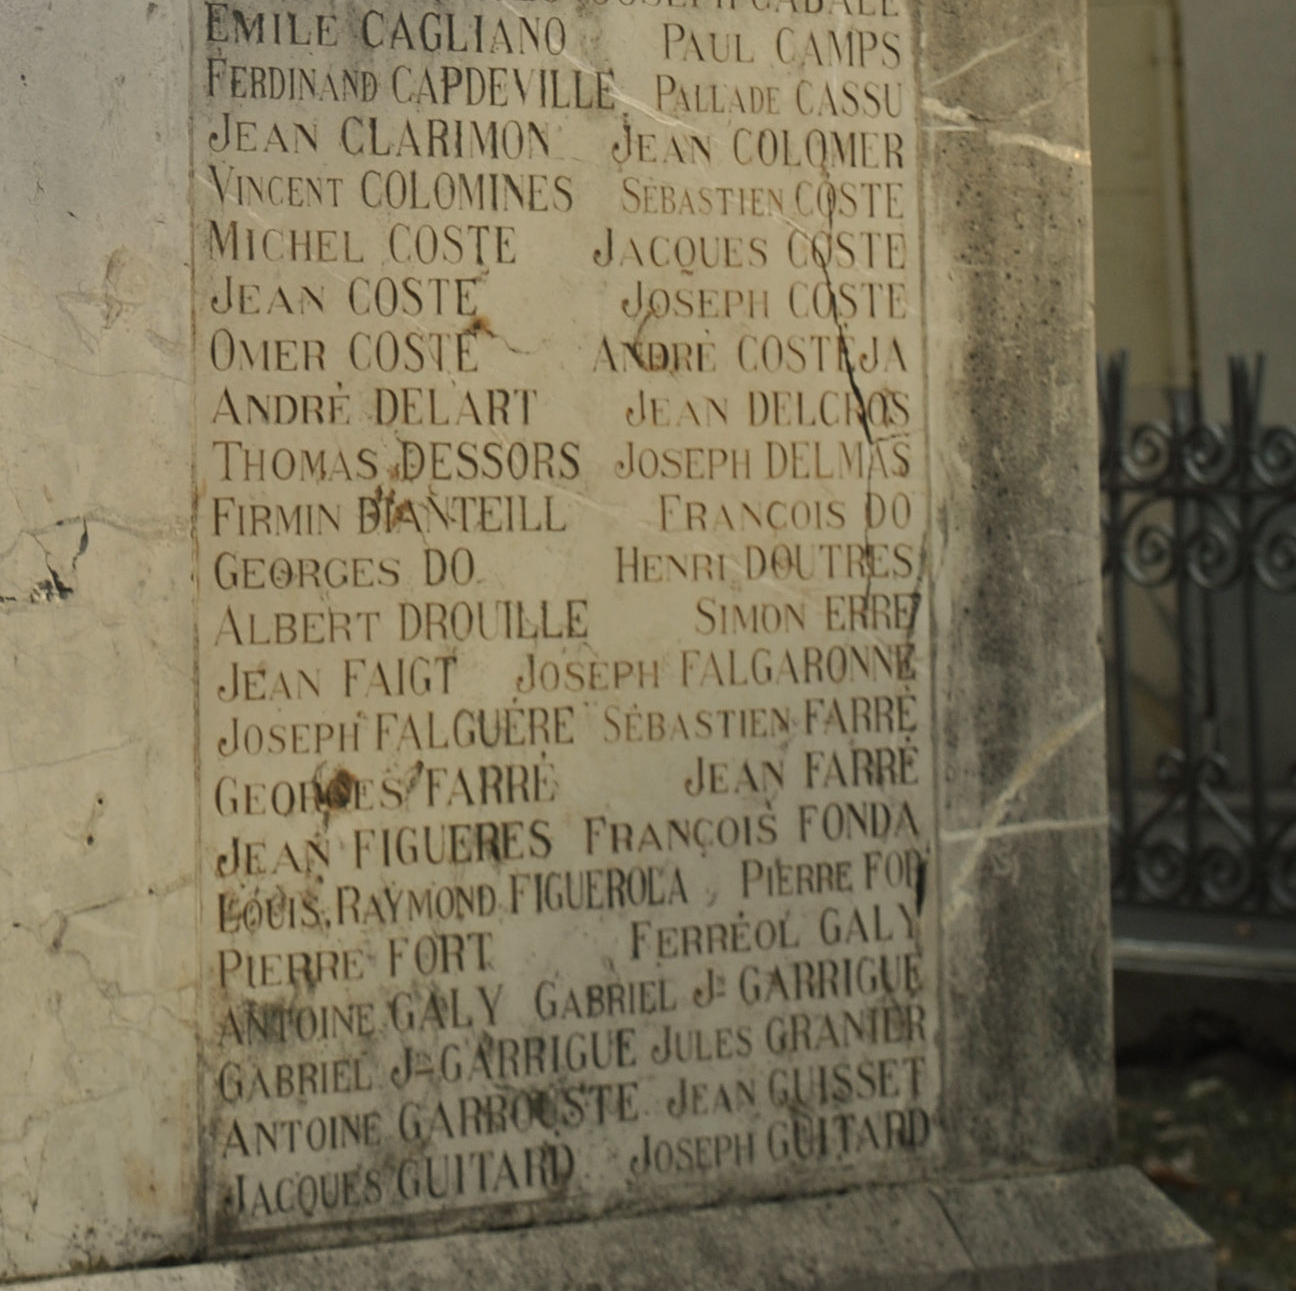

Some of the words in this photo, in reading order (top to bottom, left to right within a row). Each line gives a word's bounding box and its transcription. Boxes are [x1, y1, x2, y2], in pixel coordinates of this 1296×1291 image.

[205, 1, 338, 46] EMILE
[361, 9, 566, 55] CAGLIANO
[663, 22, 754, 64] PAUL
[776, 27, 901, 69] CAMPS
[206, 57, 378, 103] FERDINAND
[392, 65, 616, 110] CAPDEVILLE
[656, 74, 780, 115] PALLADE
[796, 80, 902, 118] CASSU
[208, 112, 318, 153] JEAN
[340, 116, 550, 160] CLARIMON
[611, 124, 712, 165] JEAN
[733, 128, 904, 169] COLOMER
[209, 165, 343, 208] VINCENT
[361, 169, 574, 212] COLOMINES
[795, 180, 904, 219] COSTE
[208, 219, 364, 263] MICHEL
[389, 222, 516, 266] COSTE
[592, 227, 768, 277] JACQUES
[787, 230, 906, 269] COSTE
[210, 275, 325, 315] JEAN
[348, 276, 479, 317] COSTE
[621, 280, 769, 319] JOSEPH
[788, 281, 905, 320] COSTE
[209, 328, 326, 372] OMER
[349, 330, 479, 373] COSTE
[592, 328, 717, 374] ANDRÉ
[211, 381, 351, 426] ANDRÉ
[374, 387, 539, 426] DELART
[625, 388, 728, 428] JEAN
[212, 440, 379, 483] THOMAS
[403, 440, 581, 481] DESSORS
[614, 440, 752, 480] JOSEPH
[765, 441, 911, 480] DELMAS
[211, 495, 341, 537] FIRMIN
[866, 492, 911, 530] DO
[213, 551, 401, 589] GEORGES
[423, 546, 475, 587] DO
[614, 545, 727, 584] HENRI
[746, 543, 913, 581] DOUTRES
[213, 603, 381, 647] ALBERT
[398, 598, 589, 642] DROUILLE
[694, 596, 805, 636] SIMON
[824, 592, 921, 632] ERRE
[217, 661, 321, 703] JEAN
[343, 656, 458, 698] FAIGT
[516, 653, 660, 694] JOSEPH
[679, 642, 917, 689] FALGARONNE
[804, 685, 917, 736] FARRÉ
[217, 717, 360, 757] JOSEPH
[214, 768, 403, 817] GEORES
[426, 750, 558, 807] FARRÉ
[684, 755, 785, 797] JEAN
[804, 735, 919, 789] FARRÉ
[799, 800, 920, 844] FONDA
[216, 836, 330, 878] JEAN
[741, 857, 854, 899] PIERRE
[335, 884, 498, 926] RAYMOND
[508, 866, 690, 915] FIGUEROLA
[819, 903, 922, 946] GALY
[218, 948, 365, 988] PIERRE
[387, 931, 495, 978] FORT
[534, 978, 678, 1022] GABRIEL
[739, 953, 924, 1007] GARRIGUE
[219, 1002, 374, 1047] ANTOINE
[391, 983, 504, 1033] GALY
[650, 1024, 753, 1065] JULES
[765, 1003, 926, 1057] GRANIER
[219, 1058, 373, 1104] GABRIEL
[439, 1027, 637, 1083] GARRIGUE
[666, 1077, 756, 1119] JEAN
[768, 1056, 926, 1107] GUISSET
[222, 1110, 382, 1159] ANTOINE
[630, 1133, 756, 1176] JOSEPH
[767, 1107, 931, 1162] GUITARD
[224, 1167, 383, 1217] JACQUES
[396, 1140, 575, 1201] GUITARD
